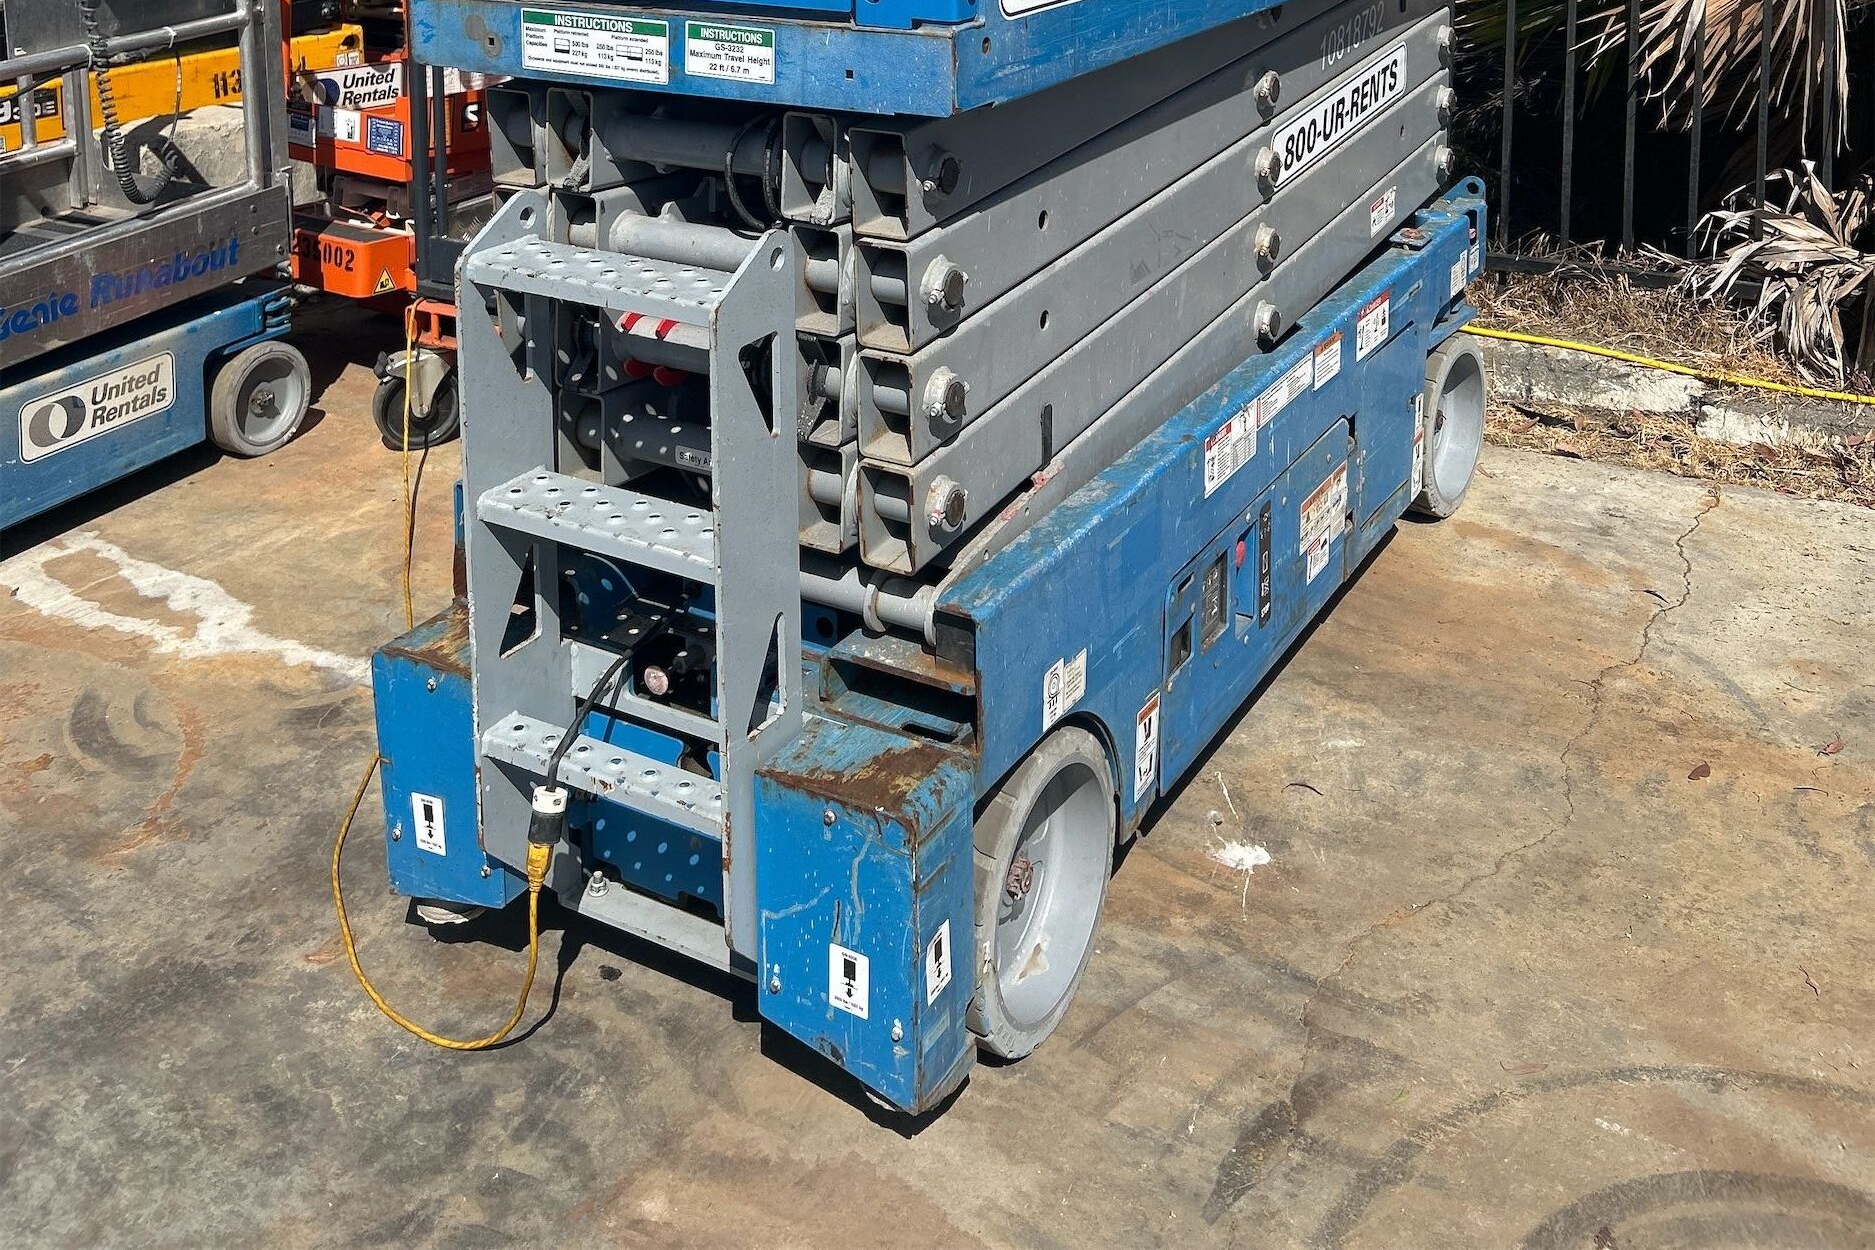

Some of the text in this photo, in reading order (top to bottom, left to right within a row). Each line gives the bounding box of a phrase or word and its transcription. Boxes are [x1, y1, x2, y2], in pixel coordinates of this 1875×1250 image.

[554, 14, 633, 33] INSTRUCTIONS
[700, 27, 763, 44] INSTRUCTIONS
[690, 49, 770, 67] Maximum Travel Height
[715, 42, 744, 53] GS-3232
[709, 63, 717, 71] 22
[719, 64, 725, 72] ft
[343, 68, 396, 89] United
[342, 85, 399, 106] Rentals
[1284, 59, 1398, 171] 800-UR-RENTS
[91, 237, 240, 310] Runabout
[92, 362, 161, 406] United
[91, 385, 168, 429] Rentals
